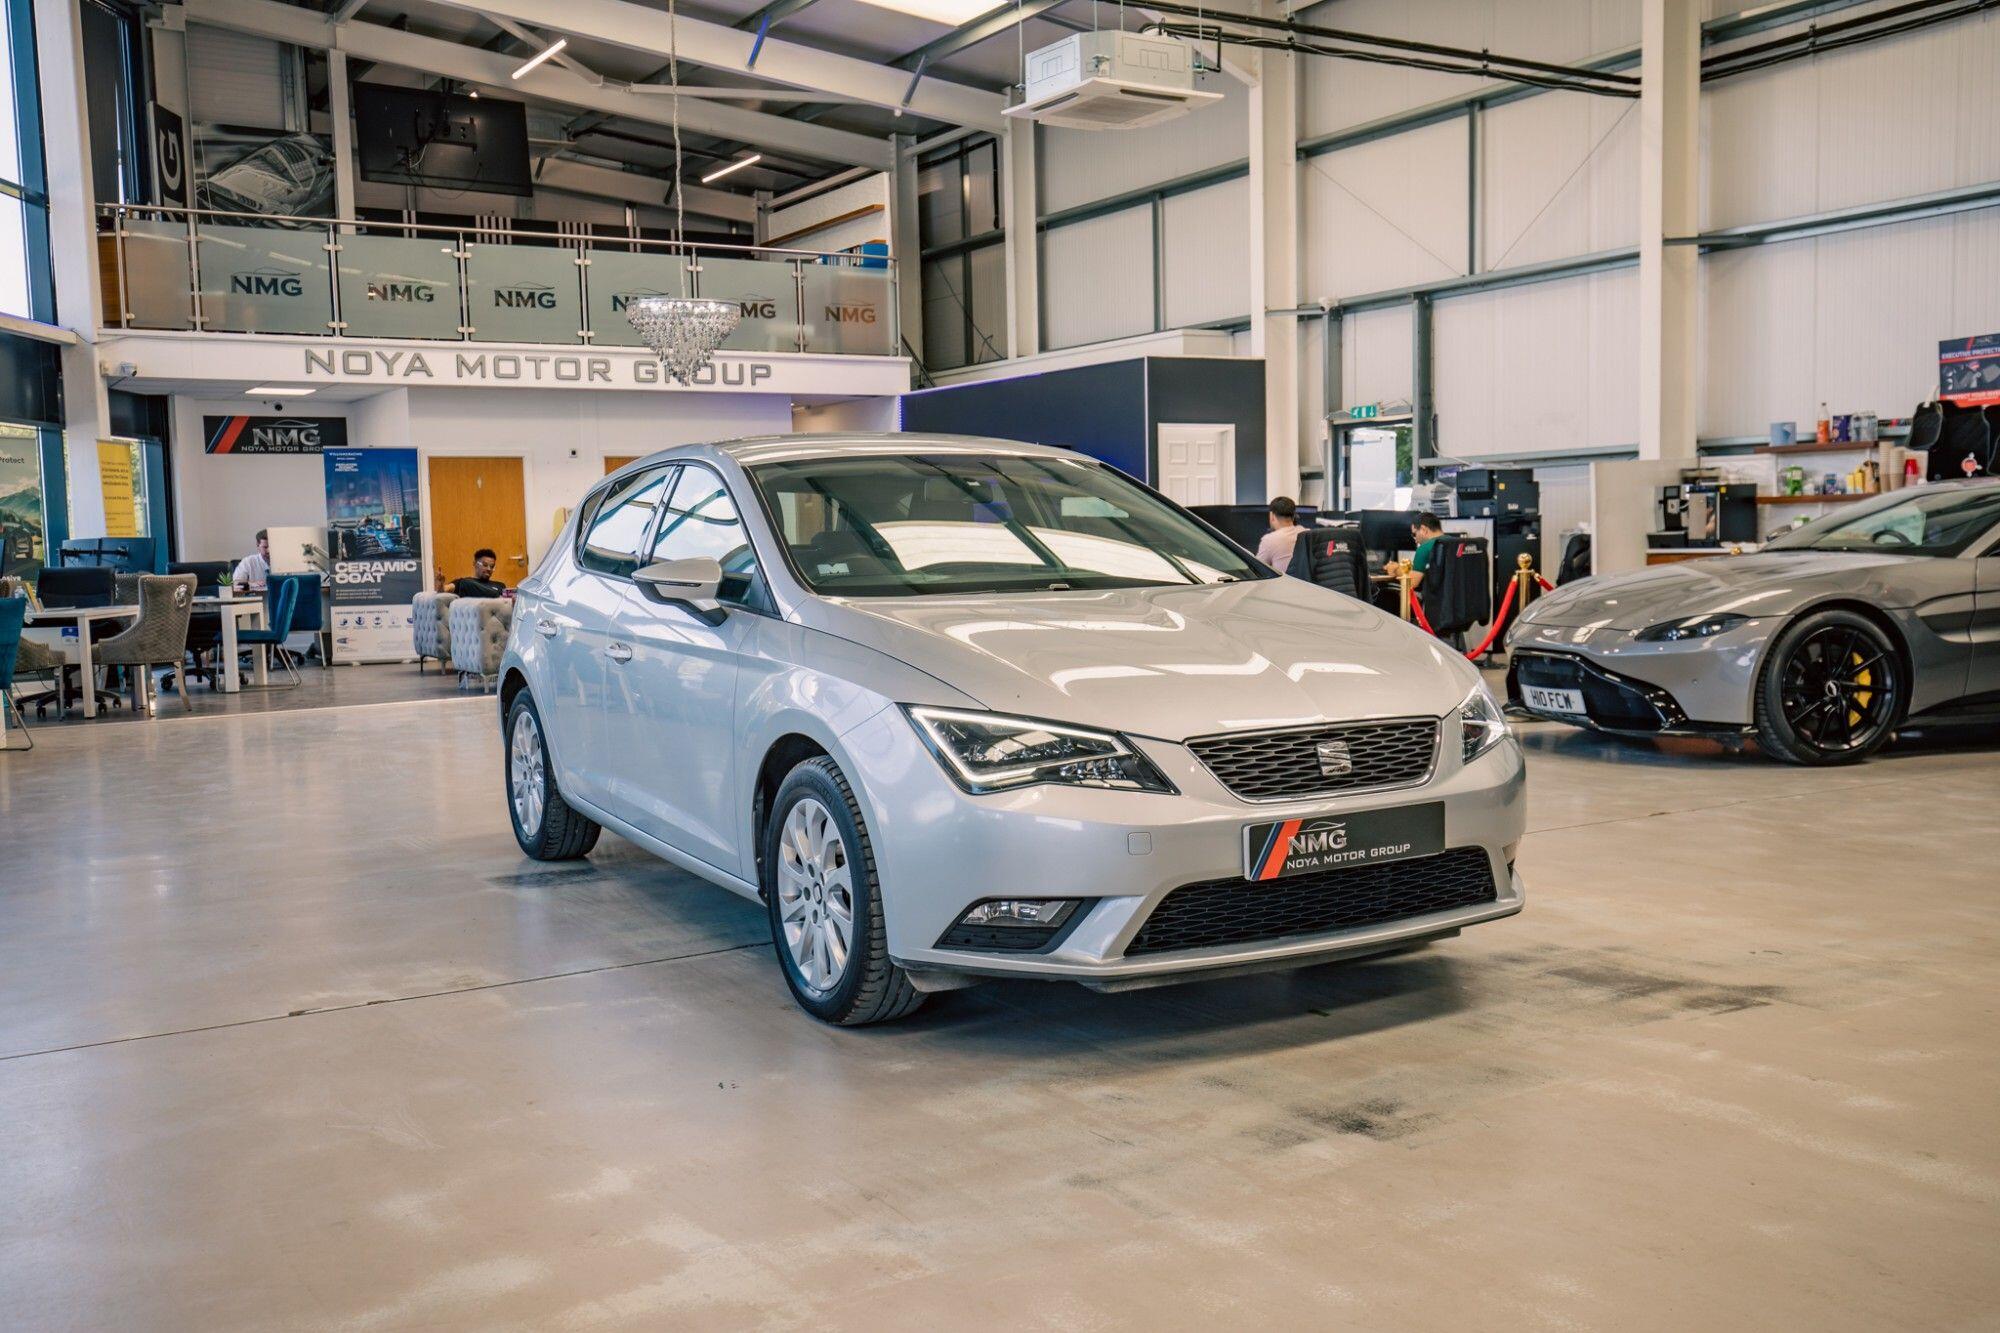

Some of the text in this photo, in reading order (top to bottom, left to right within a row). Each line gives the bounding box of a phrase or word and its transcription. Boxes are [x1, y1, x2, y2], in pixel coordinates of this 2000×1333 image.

[230, 275, 303, 297] NMG
[367, 283, 434, 303] NMG
[493, 289, 557, 308] NMG
[740, 302, 776, 319] MG
[824, 306, 875, 324] NMG
[305, 349, 434, 377] NOYA
[456, 353, 612, 382] MOTOR
[252, 428, 321, 446] NMG
[334, 560, 417, 573] CERAMIC
[335, 572, 385, 584] COAT
[1547, 691, 1573, 710] FCM
[1287, 829, 1348, 856] NMG
[1286, 843, 1411, 869] NOYA MOTOR GROUP
